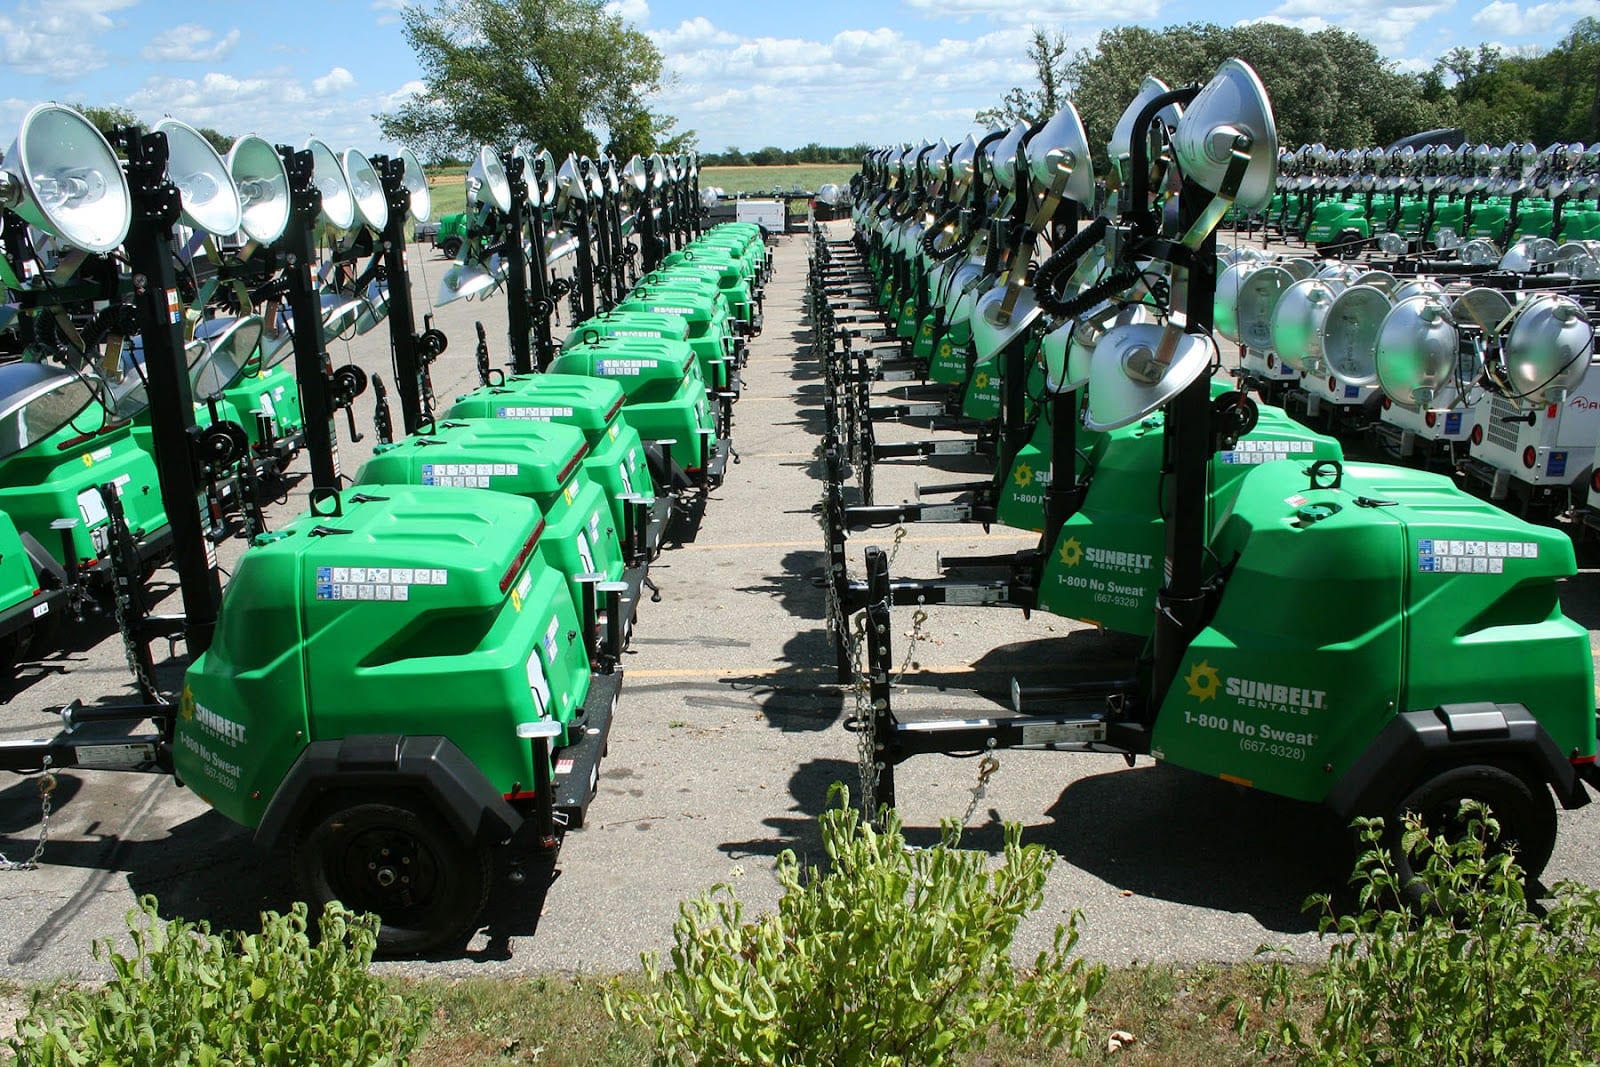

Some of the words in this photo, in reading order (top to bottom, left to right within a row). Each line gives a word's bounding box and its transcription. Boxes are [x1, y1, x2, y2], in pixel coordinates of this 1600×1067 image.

[1013, 493, 1037, 504] 1-800
[1085, 547, 1152, 569] SUNBELT
[1093, 562, 1140, 574] RENTALS
[1058, 574, 1087, 588] 1-800
[1089, 579, 1105, 591] No
[1107, 581, 1144, 597] Sweat
[1094, 593, 1139, 608] (667-9328)
[1225, 677, 1327, 710] SUNBELT
[1237, 697, 1309, 715] RENTALS
[195, 702, 246, 743] SUNBELT
[1184, 711, 1228, 731] 1-800
[1232, 719, 1255, 736] No
[1259, 724, 1313, 746] Sweat
[180, 731, 199, 754] 1-800
[199, 743, 211, 762] No
[212, 752, 240, 778] Sweat
[1239, 738, 1306, 762] (667-9328)
